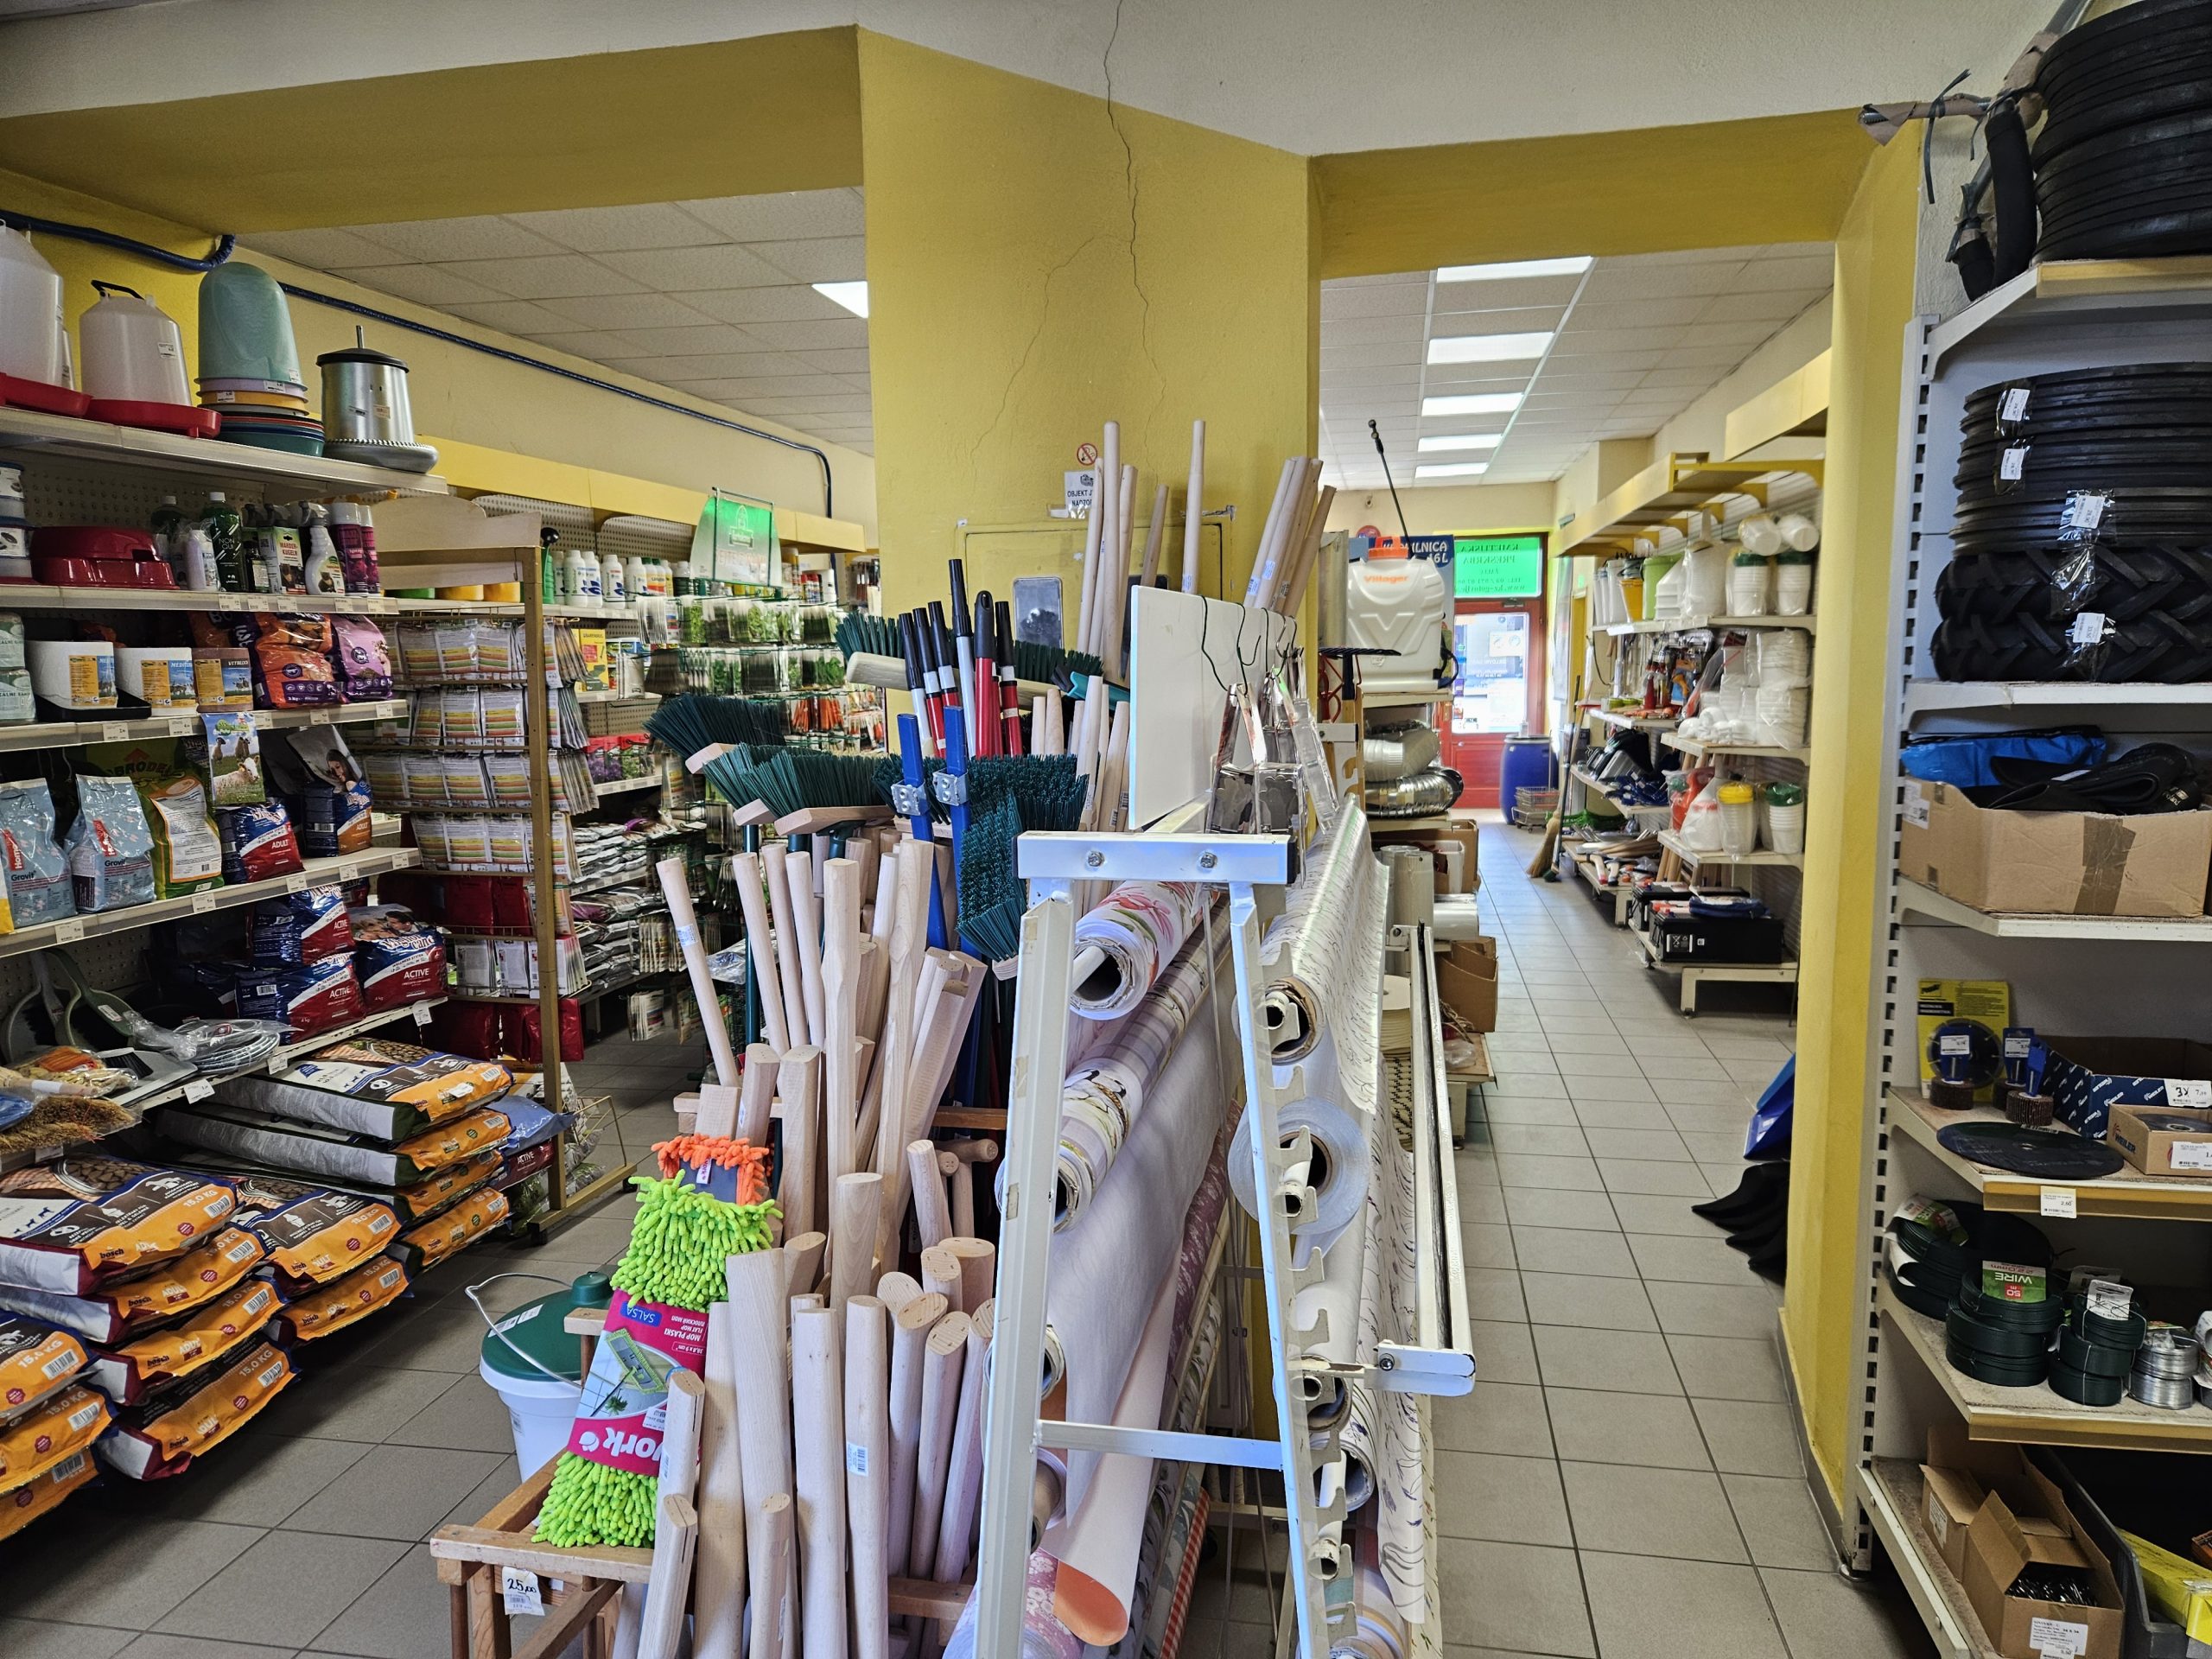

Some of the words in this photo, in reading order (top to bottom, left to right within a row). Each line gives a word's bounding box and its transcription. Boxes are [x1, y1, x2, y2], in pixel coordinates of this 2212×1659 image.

[1363, 575, 1408, 584] Villager
[356, 822, 368, 831] ADULT
[271, 838, 289, 849] ADULT
[105, 858, 127, 868] Grovit
[11, 870, 35, 881] Grovit
[411, 935, 435, 950] cane
[404, 968, 430, 979] ACTIVE
[329, 987, 351, 999] ACTIVE
[2115, 1135, 2136, 1154] WEILER
[517, 1152, 534, 1164] ACTIVE
[183, 1194, 203, 1208] 15,0
[203, 1189, 219, 1201] KG
[224, 1231, 240, 1245] KG
[100, 1247, 124, 1259] bosch
[1994, 1272, 2033, 1285] WIRE
[2006, 1287, 2022, 1298] 50
[128, 1296, 152, 1307] bosch
[626, 1305, 656, 1324] SALSA
[664, 1327, 686, 1339] PŁASKI
[686, 1333, 702, 1342] MOP
[17, 1350, 45, 1370] 15,0
[46, 1338, 63, 1356] KG
[147, 1354, 170, 1368] bosch
[238, 1360, 259, 1377] 15,0
[258, 1349, 274, 1363] KG
[46, 1399, 71, 1416] 15,0
[72, 1389, 87, 1405] KG
[169, 1436, 189, 1449] bosch
